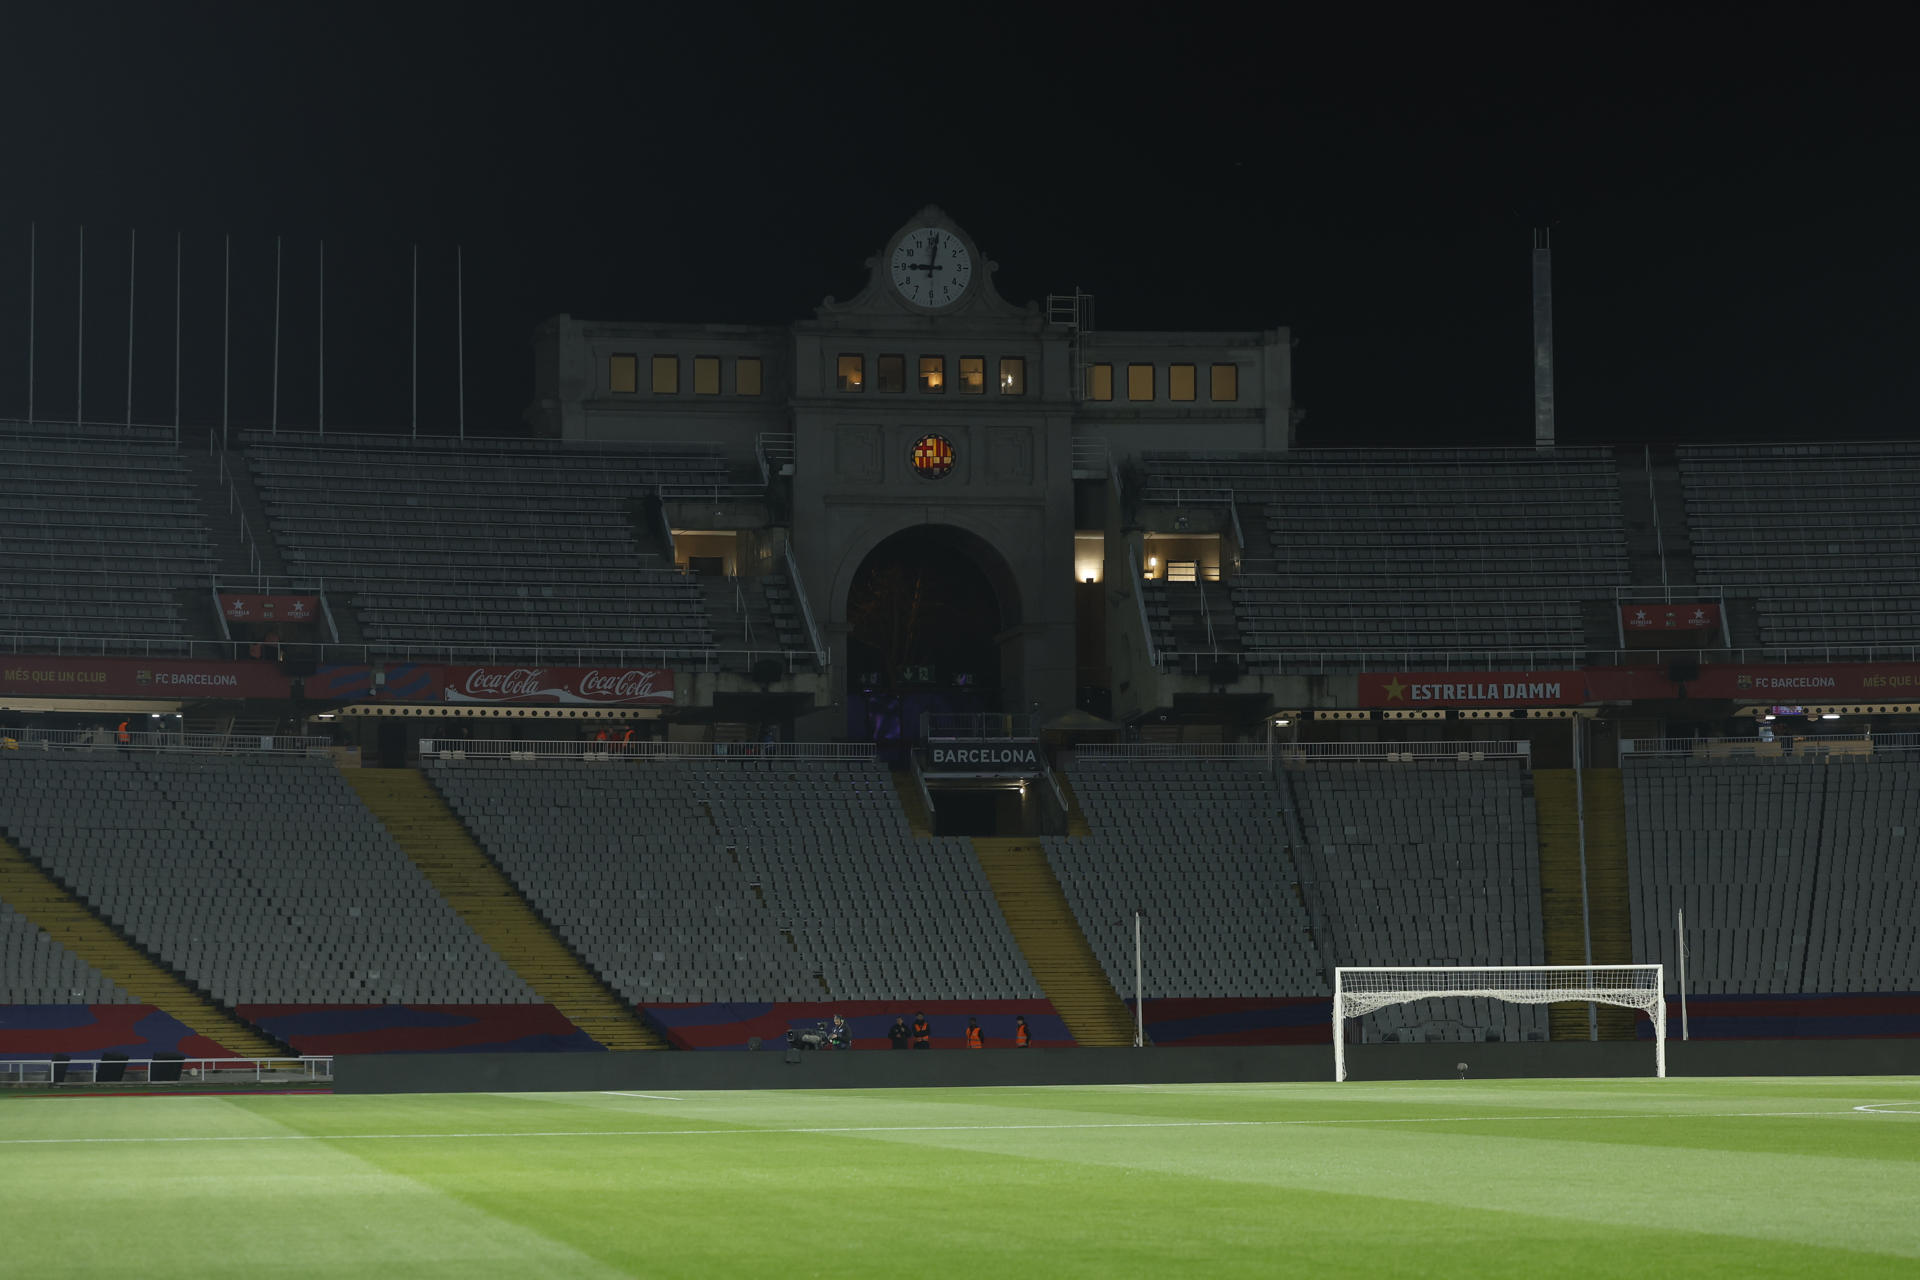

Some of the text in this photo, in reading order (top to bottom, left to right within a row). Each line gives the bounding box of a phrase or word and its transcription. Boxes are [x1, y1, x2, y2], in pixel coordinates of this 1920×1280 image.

[916, 240, 922, 248] 11
[907, 249, 914, 257] 10
[952, 249, 957, 258] 2
[901, 262, 907, 271] 9
[956, 263, 962, 272] 3
[905, 276, 911, 285] 8
[951, 278, 957, 286] 4
[943, 285, 948, 294] 5
[928, 290, 934, 299] 6
[4, 669, 107, 683] MÉS QUE UN CLUB
[155, 673, 238, 686] FC BARCELONA
[1863, 673, 1887, 688] MÉS
[1889, 675, 1913, 688] QUE
[1755, 677, 1836, 689] FC BARCELONA
[1411, 682, 1561, 700] ESTRELLA DAMM
[933, 749, 1036, 763] BARCELONA
